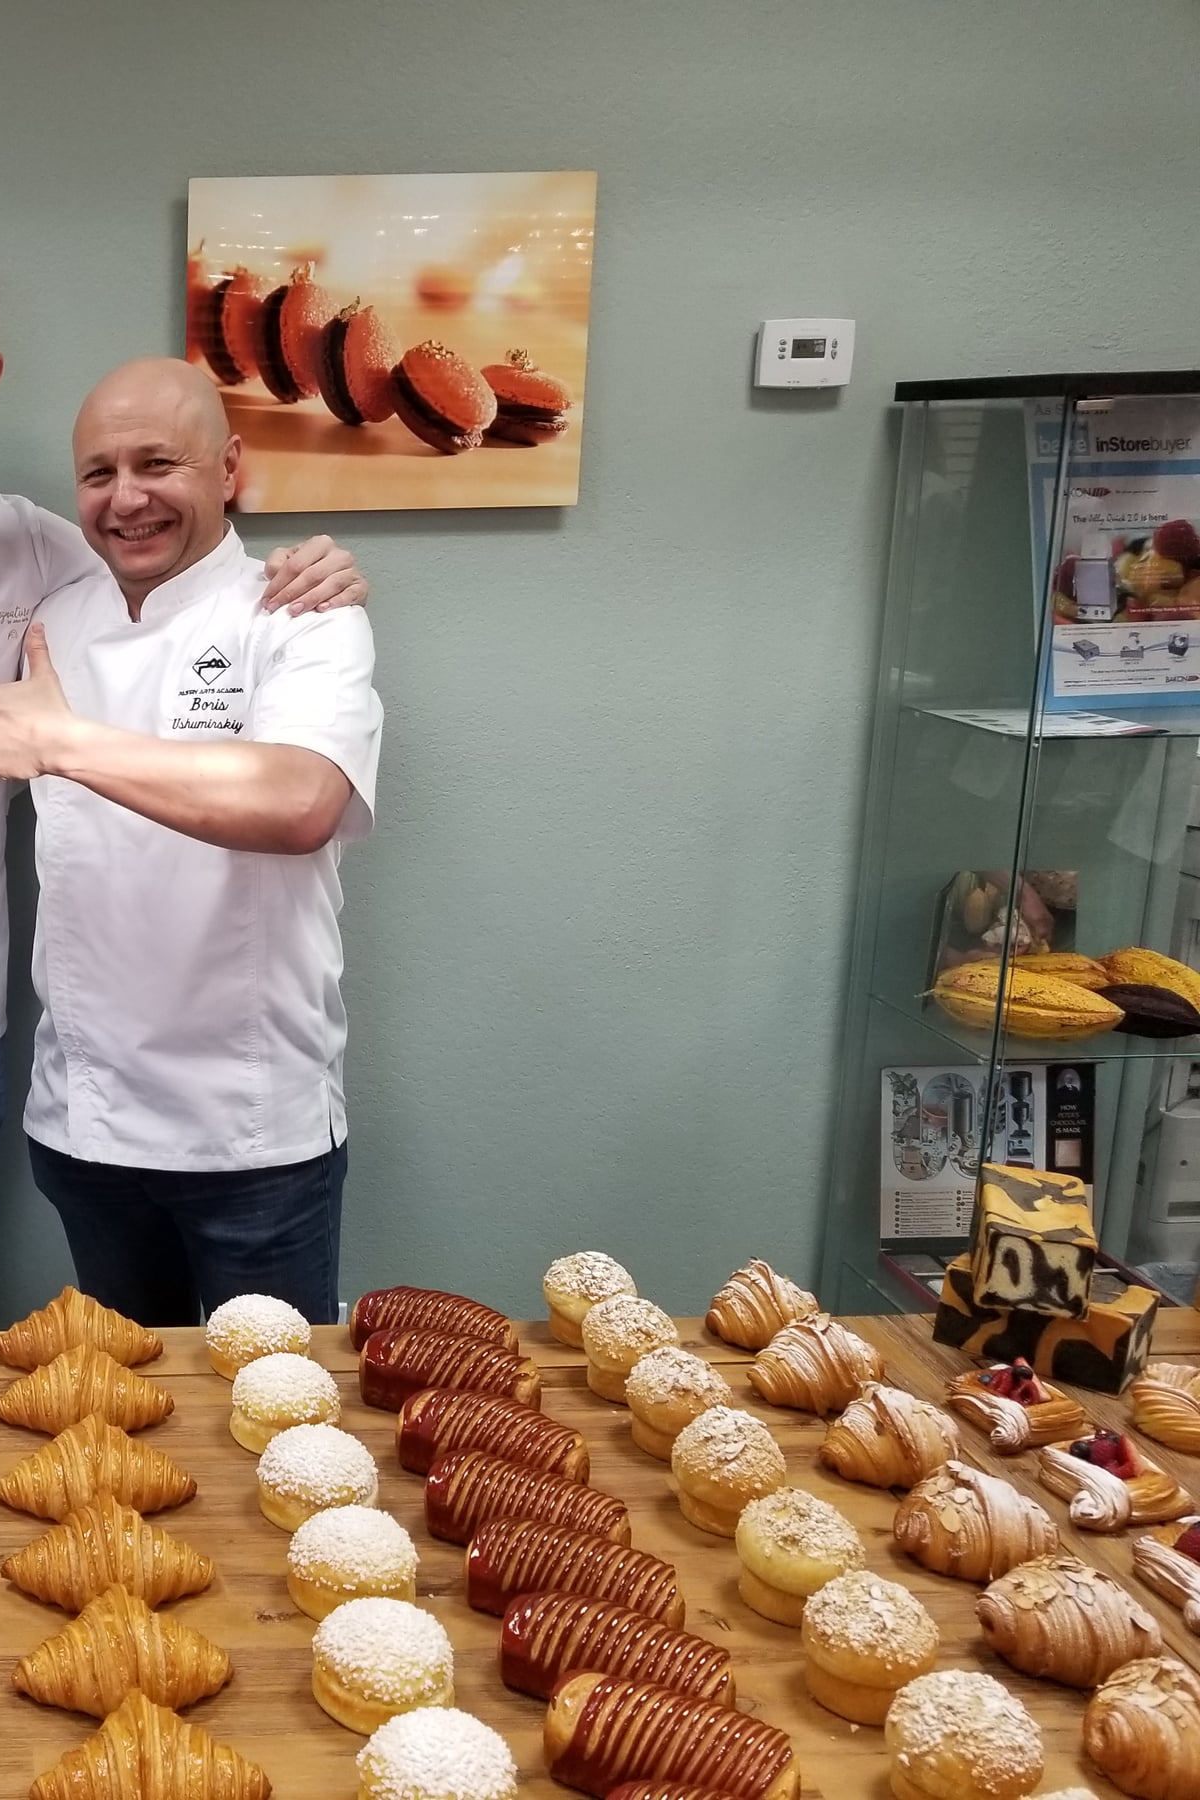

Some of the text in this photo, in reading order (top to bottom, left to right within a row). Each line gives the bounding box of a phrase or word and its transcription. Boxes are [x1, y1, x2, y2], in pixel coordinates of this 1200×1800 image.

[1096, 436, 1191, 454] inStorebuyer
[1072, 515, 1086, 523] The
[189, 697, 229, 711] Boris
